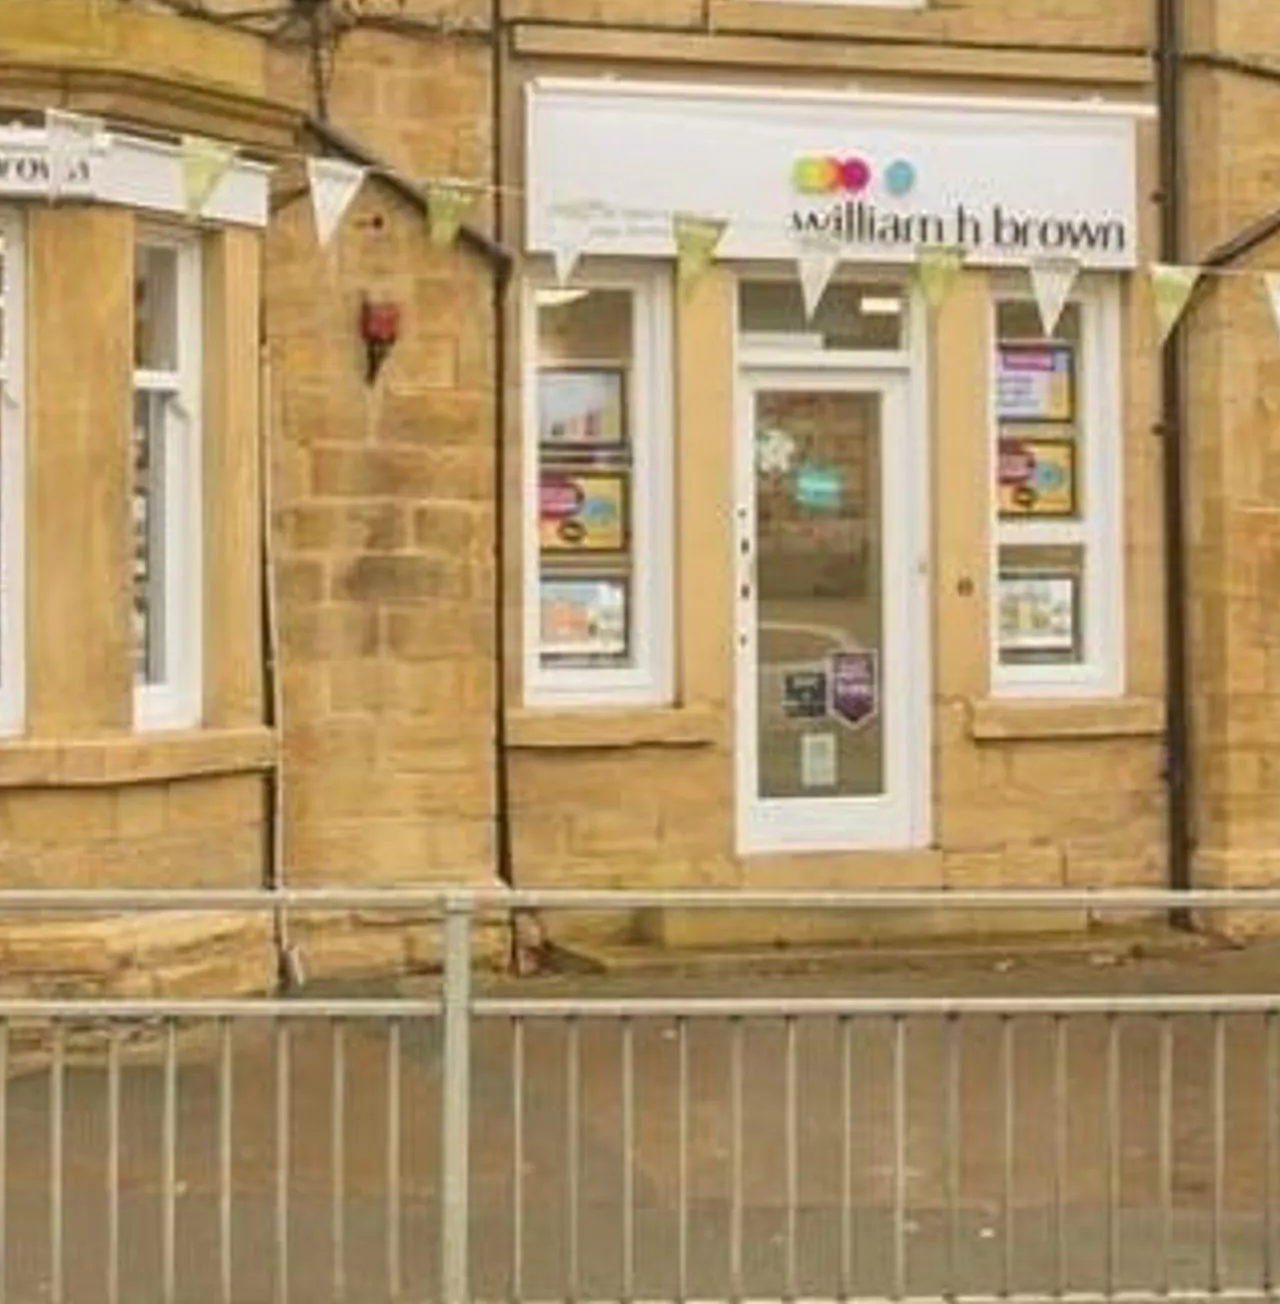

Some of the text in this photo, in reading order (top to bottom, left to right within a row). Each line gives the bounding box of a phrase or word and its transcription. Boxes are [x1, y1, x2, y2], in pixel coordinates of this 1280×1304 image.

[791, 200, 1125, 250] william h brown
